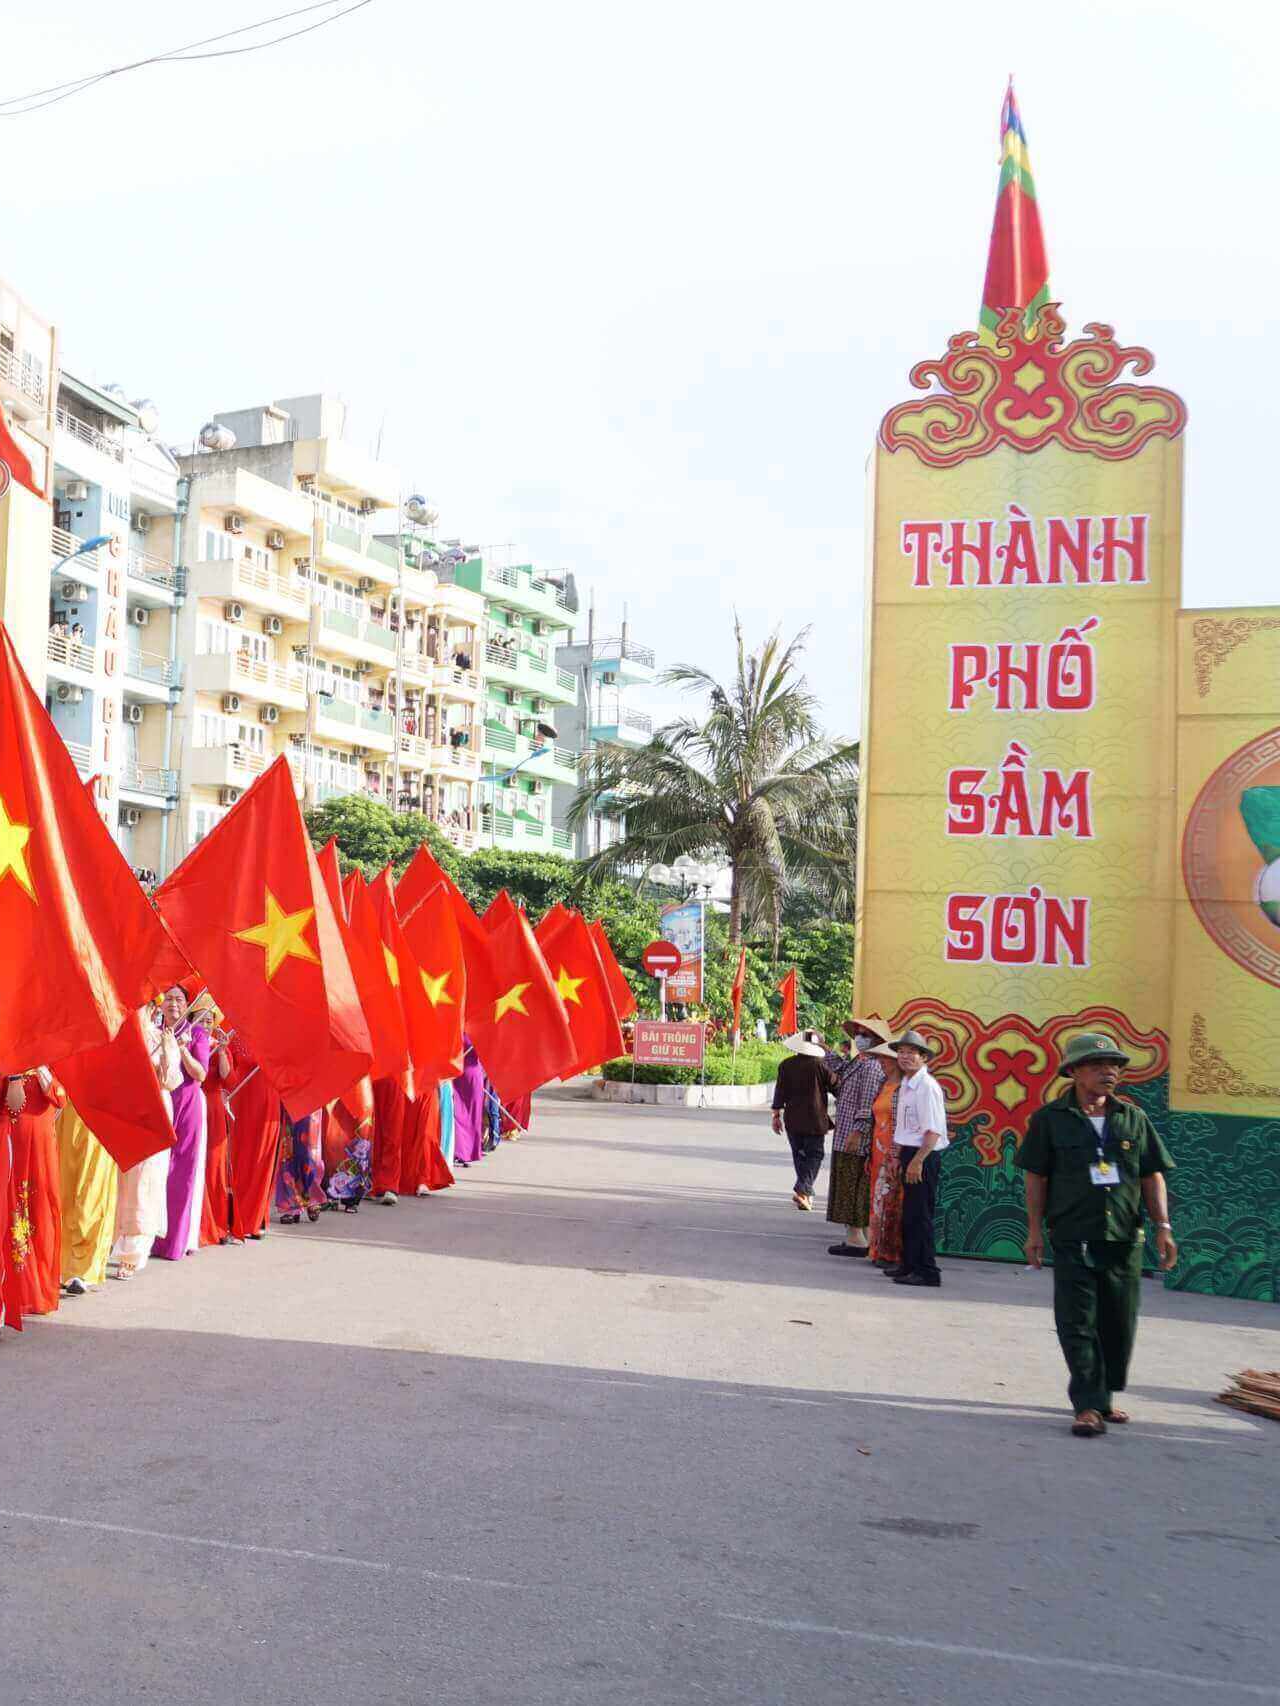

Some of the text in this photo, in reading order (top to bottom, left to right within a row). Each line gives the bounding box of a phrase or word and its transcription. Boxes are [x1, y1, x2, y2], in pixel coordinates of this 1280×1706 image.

[901, 503, 1150, 587] THÀNH
[949, 616, 1099, 712] PHỐ
[946, 740, 1095, 838] SẦM
[945, 886, 1090, 967] SƠN
[672, 1046, 686, 1056] XE
